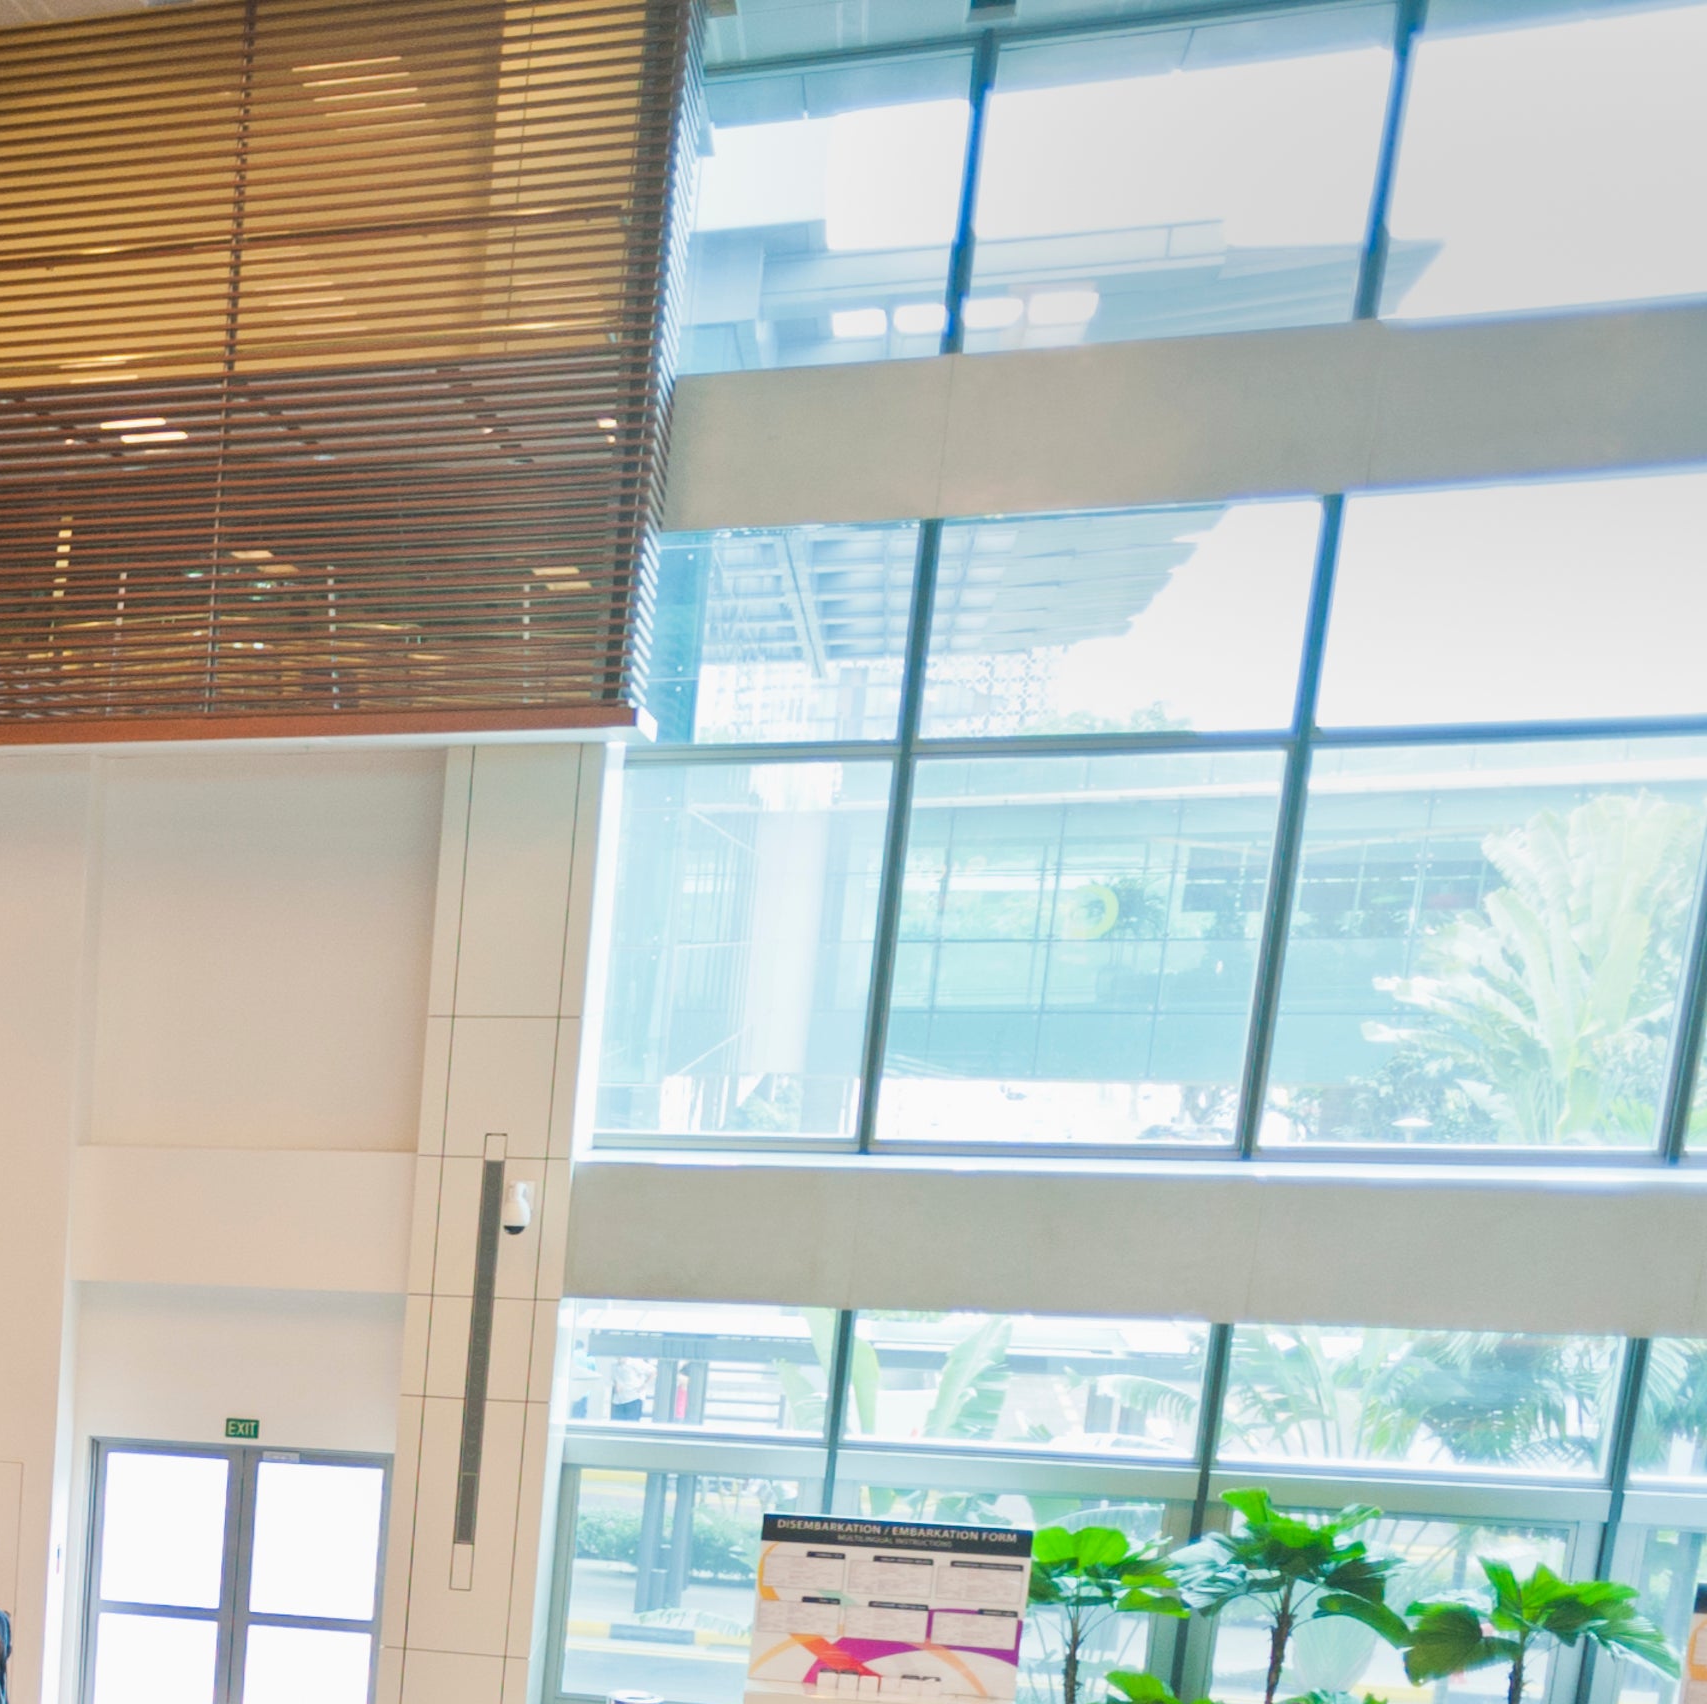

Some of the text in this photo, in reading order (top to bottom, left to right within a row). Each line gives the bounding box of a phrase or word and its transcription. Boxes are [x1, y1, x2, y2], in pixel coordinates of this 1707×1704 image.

[228, 1420, 257, 1437] EXIT
[776, 1518, 882, 1536] DISEMBARKATION
[891, 1527, 979, 1543] EMBARKATION
[982, 1531, 1018, 1544] FORM
